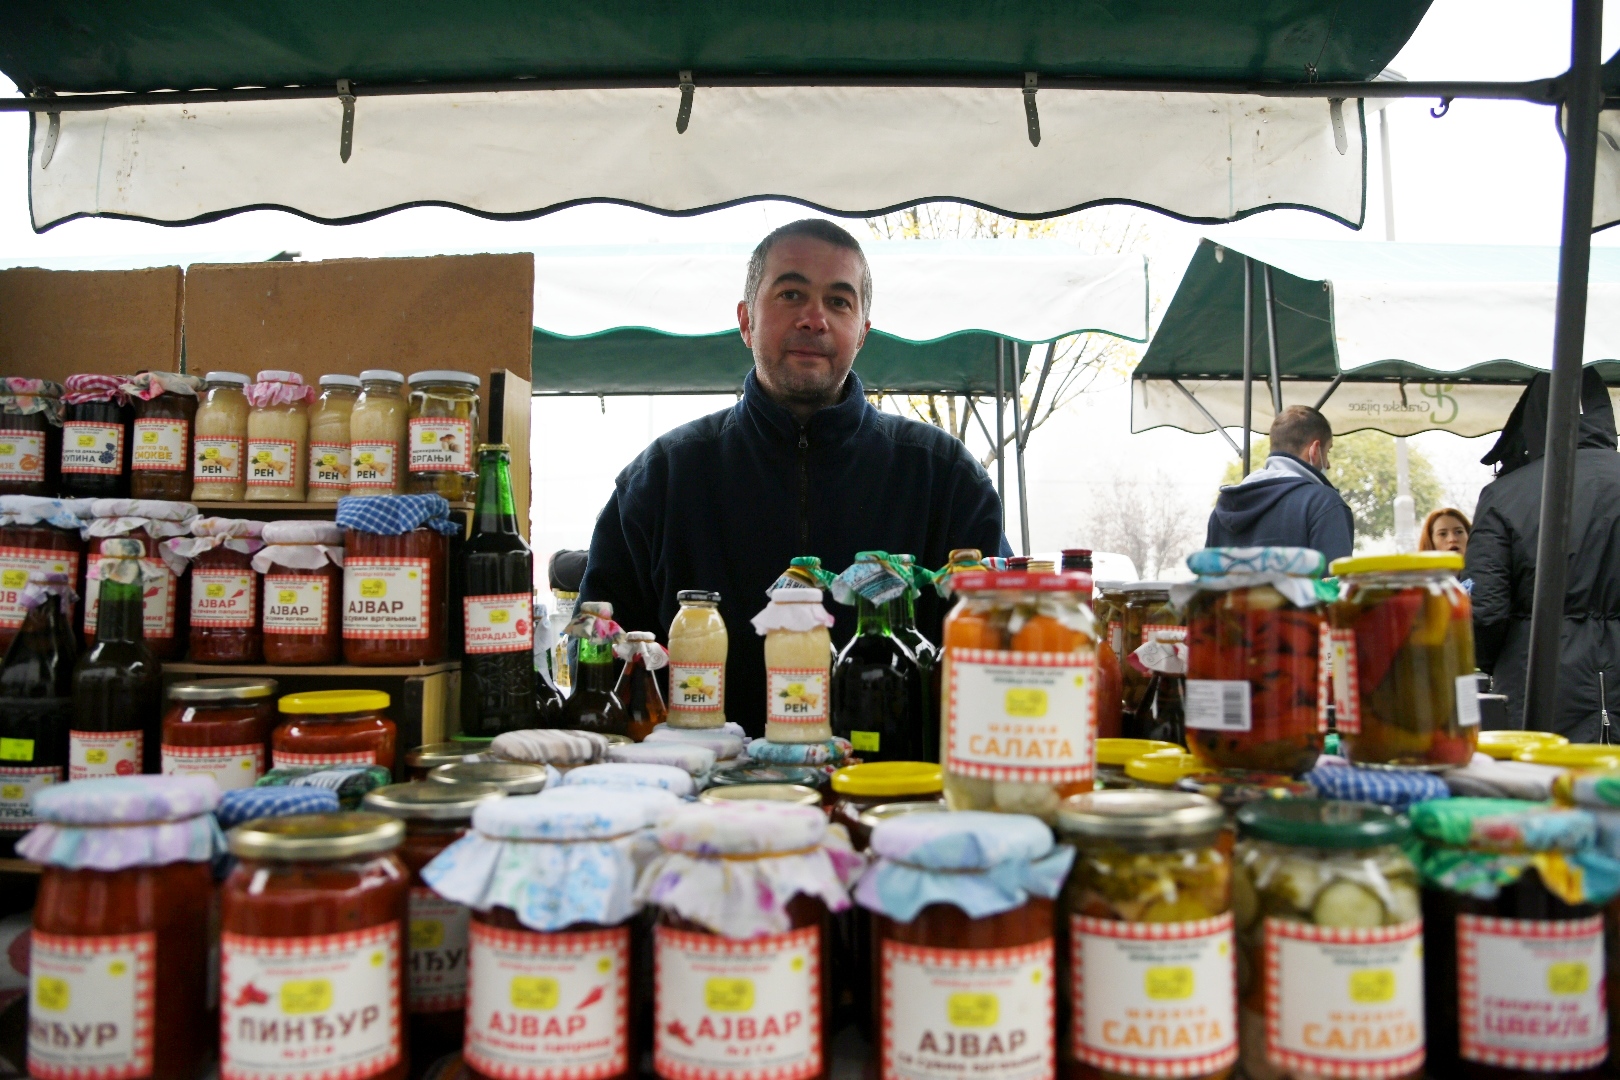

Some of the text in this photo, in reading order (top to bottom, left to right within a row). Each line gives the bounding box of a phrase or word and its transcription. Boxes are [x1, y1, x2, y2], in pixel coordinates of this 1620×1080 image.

[412, 455, 452, 463] ВРГАЊИ
[254, 469, 274, 477] РЕН
[319, 471, 338, 480] РЕН
[198, 599, 237, 608] АЈВАР
[349, 601, 404, 613] АЈВАР
[270, 606, 309, 615] АЈВАР
[471, 632, 517, 640] ПАРАДАЈЗ
[684, 694, 705, 703] РЕН
[784, 703, 808, 713] РЕН
[969, 734, 1074, 759] САЛАТА
[238, 1004, 381, 1042] ПИНЂУР
[488, 1010, 588, 1037] АЈВАР
[696, 1010, 802, 1041] АЈВАР
[1101, 1018, 1223, 1049] САЛАТА
[1302, 1021, 1419, 1051] САЛАТА
[918, 1029, 1027, 1057] АЈВАР
